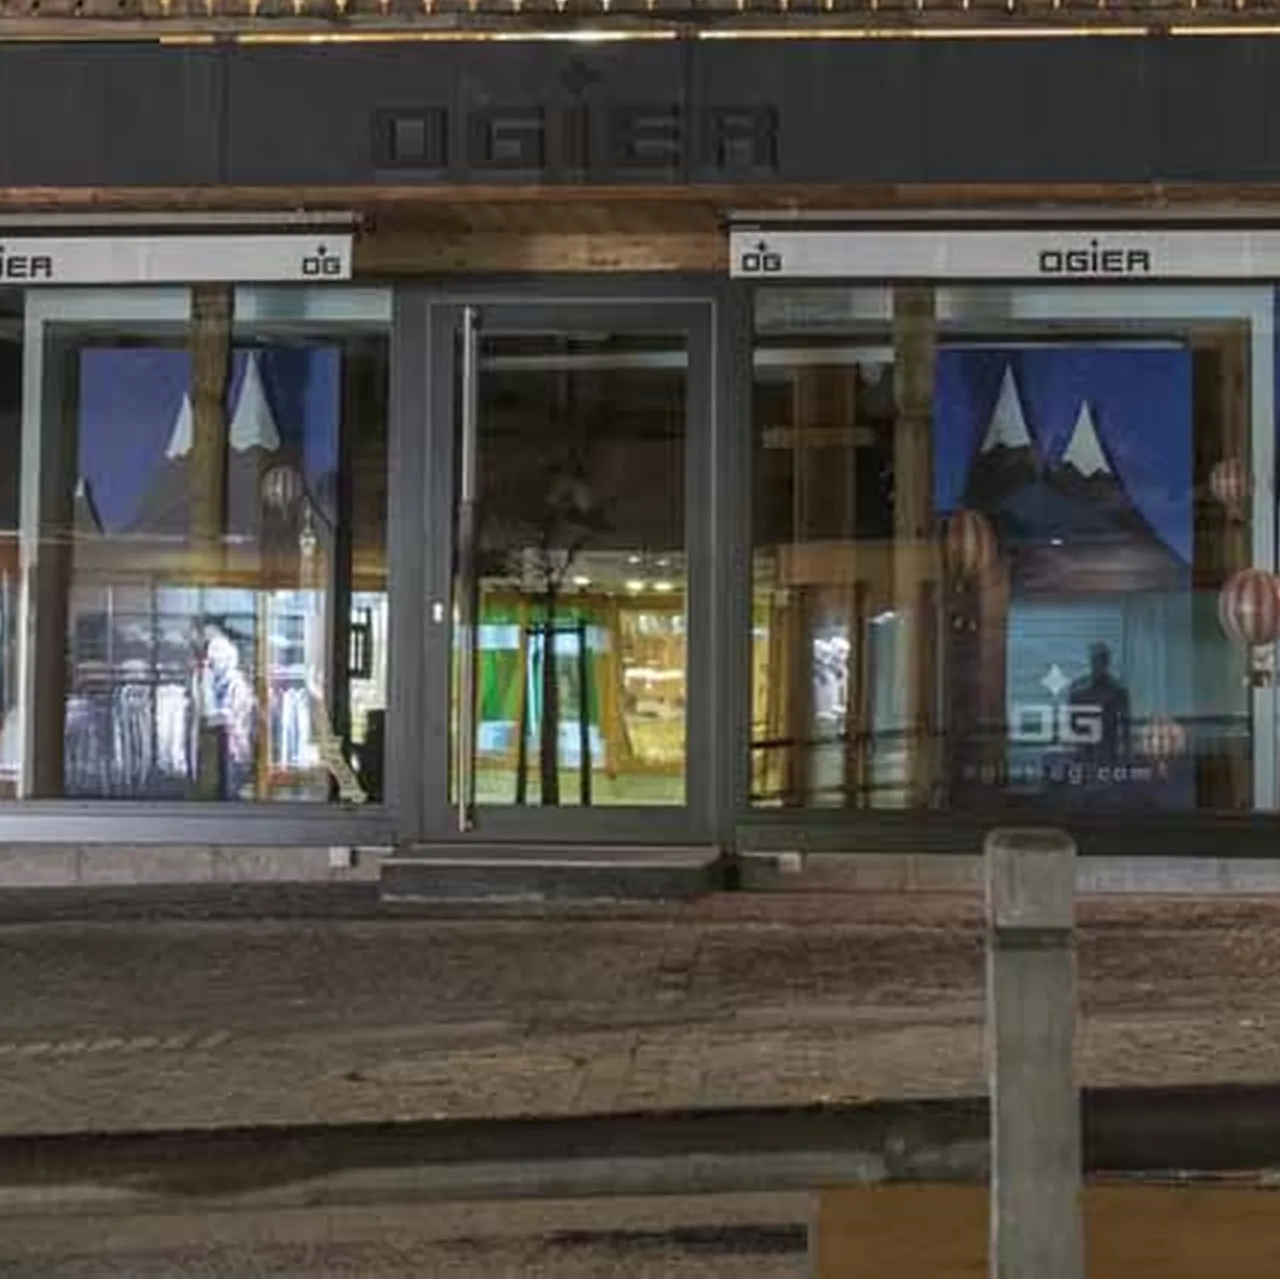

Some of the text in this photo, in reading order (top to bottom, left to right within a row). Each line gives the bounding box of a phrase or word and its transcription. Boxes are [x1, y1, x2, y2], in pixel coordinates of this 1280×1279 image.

[301, 253, 342, 276] OG
[741, 248, 782, 272] OG
[1009, 704, 1104, 744] OG
